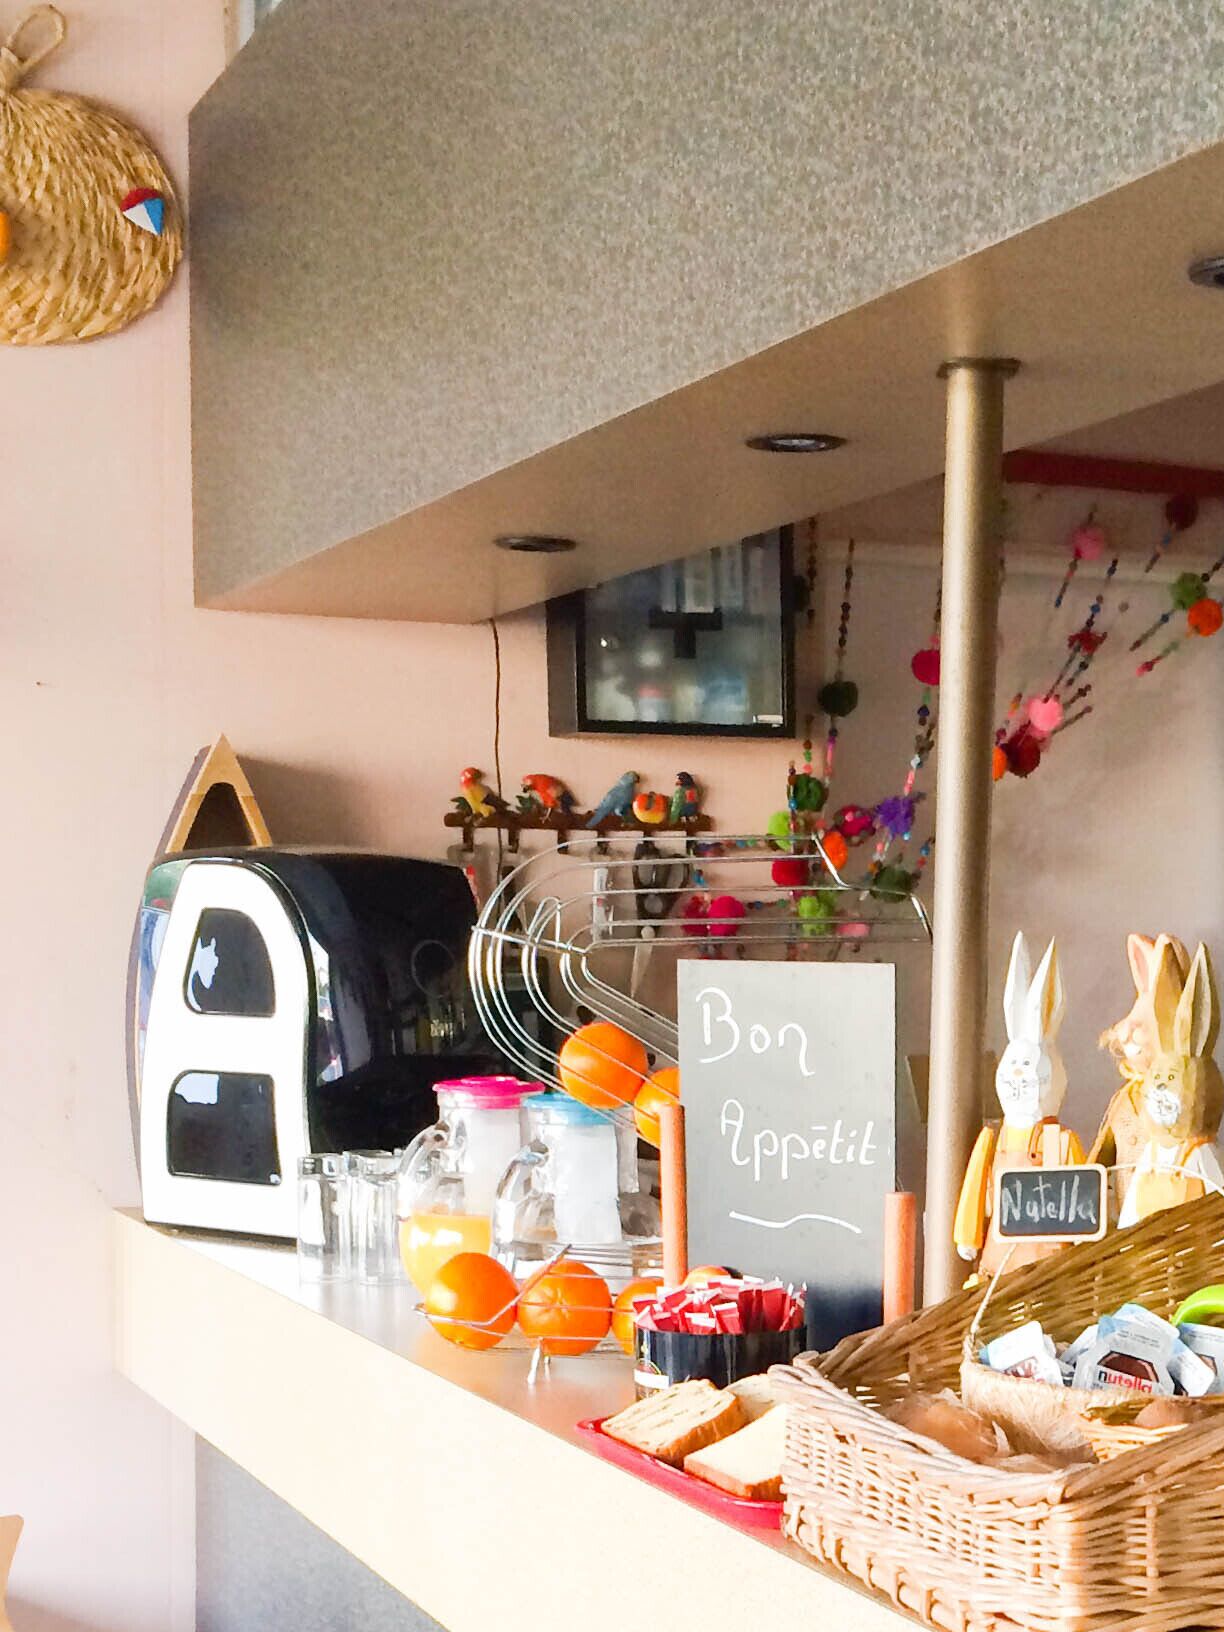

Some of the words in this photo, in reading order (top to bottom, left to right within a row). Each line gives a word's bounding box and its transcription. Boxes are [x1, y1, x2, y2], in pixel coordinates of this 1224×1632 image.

[696, 987, 815, 1076] Bon
[1001, 1174, 1097, 1227] Nutella
[1098, 1369, 1153, 1393] nutella
